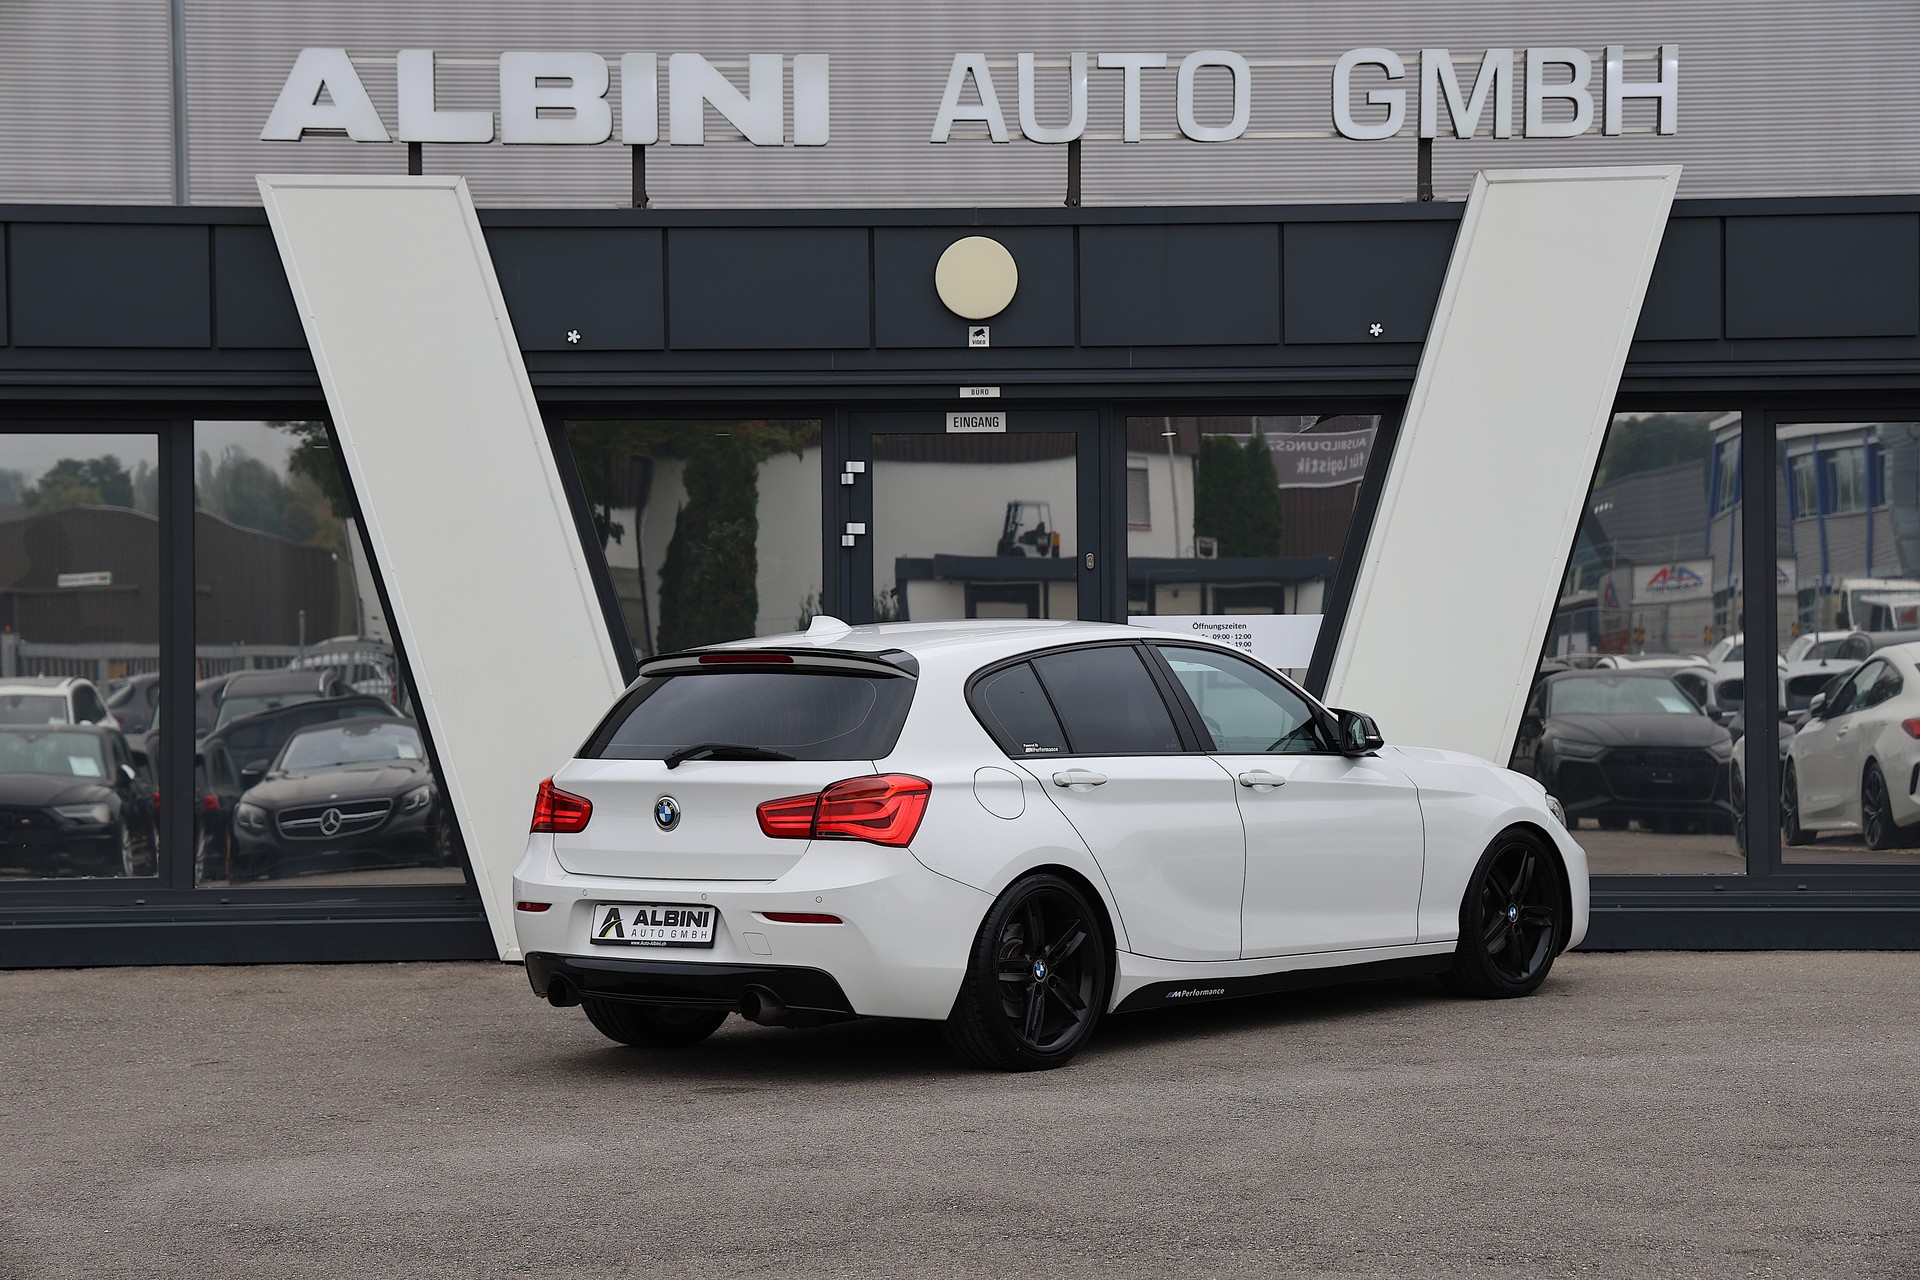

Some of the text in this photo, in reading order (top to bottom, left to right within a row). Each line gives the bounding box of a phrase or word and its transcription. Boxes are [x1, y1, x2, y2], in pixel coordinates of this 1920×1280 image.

[260, 44, 1680, 146] ALBINI AUTO GMBH
[971, 387, 990, 396] BÜRO
[953, 416, 1000, 428] EINGANG
[1192, 622, 1247, 631] Öffnungszeiten
[633, 910, 710, 927] ALBINI
[631, 928, 707, 939] AUTO GMBH
